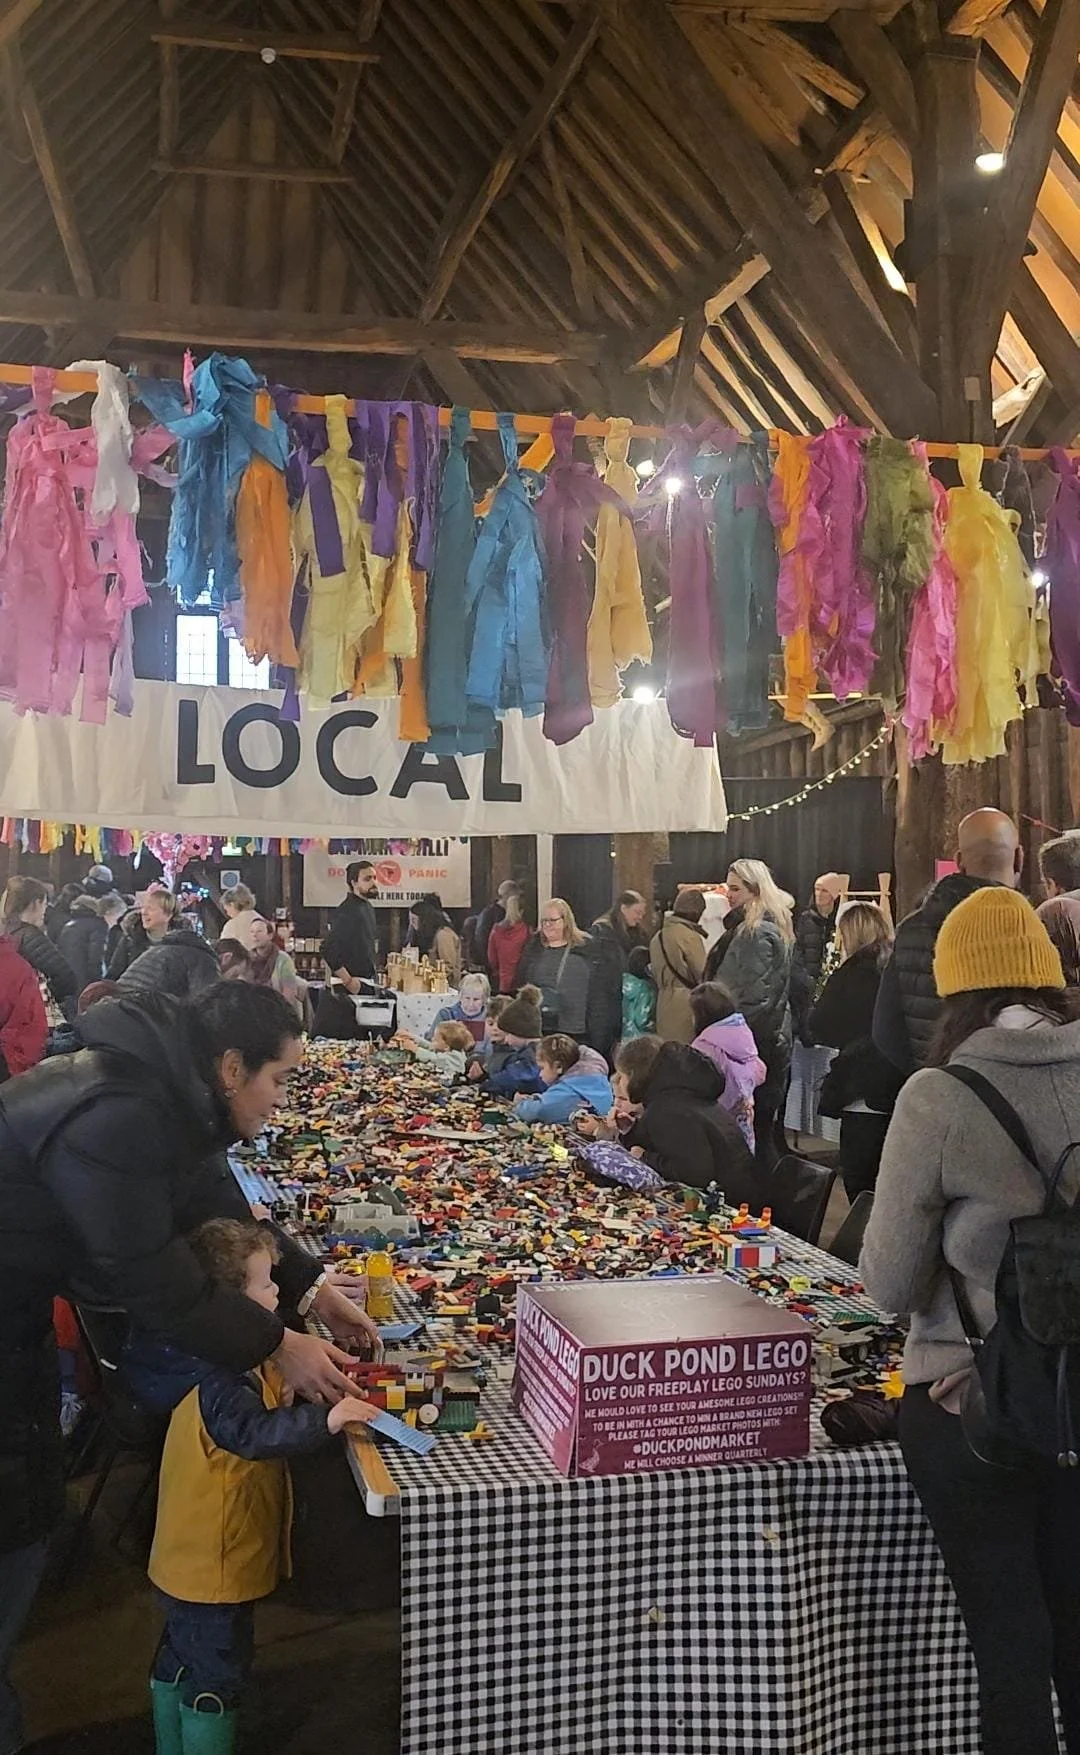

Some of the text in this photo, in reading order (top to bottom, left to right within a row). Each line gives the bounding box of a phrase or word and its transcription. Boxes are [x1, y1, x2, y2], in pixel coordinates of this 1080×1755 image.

[177, 699, 522, 802] LOCAL
[408, 868, 448, 878] PANIC
[386, 892, 403, 900] HERE
[406, 892, 424, 900] TODA
[558, 1336, 580, 1380] LEGO
[583, 1351, 656, 1383] DUCK
[664, 1345, 736, 1377] POND
[743, 1339, 808, 1371] LEGO
[585, 1371, 806, 1401] LOVE OUR FREEPLAY LEGO SUNDAYS?
[584, 1409, 596, 1418] WE
[598, 1407, 625, 1417] WOULD
[625, 1405, 646, 1415] LOVE
[648, 1404, 658, 1413] TO
[659, 1402, 674, 1412] SEE
[676, 1401, 697, 1411] YOUR
[698, 1398, 735, 1409] AWESOME
[736, 1395, 756, 1406] LEGO
[593, 1405, 798, 1432] TO BE IN WITH A CHANCE TO WIN A BRAND NEW LEGO SET
[608, 1431, 638, 1442] PLEASE
[640, 1429, 656, 1440] TAG
[657, 1427, 678, 1438] YOUR
[679, 1425, 699, 1436] LEGO
[700, 1422, 732, 1434] MARKET
[732, 1420, 761, 1431] PHOTOS
[624, 1447, 768, 1470] WE WILL CHOOSE A WINNER QUARTERLY
